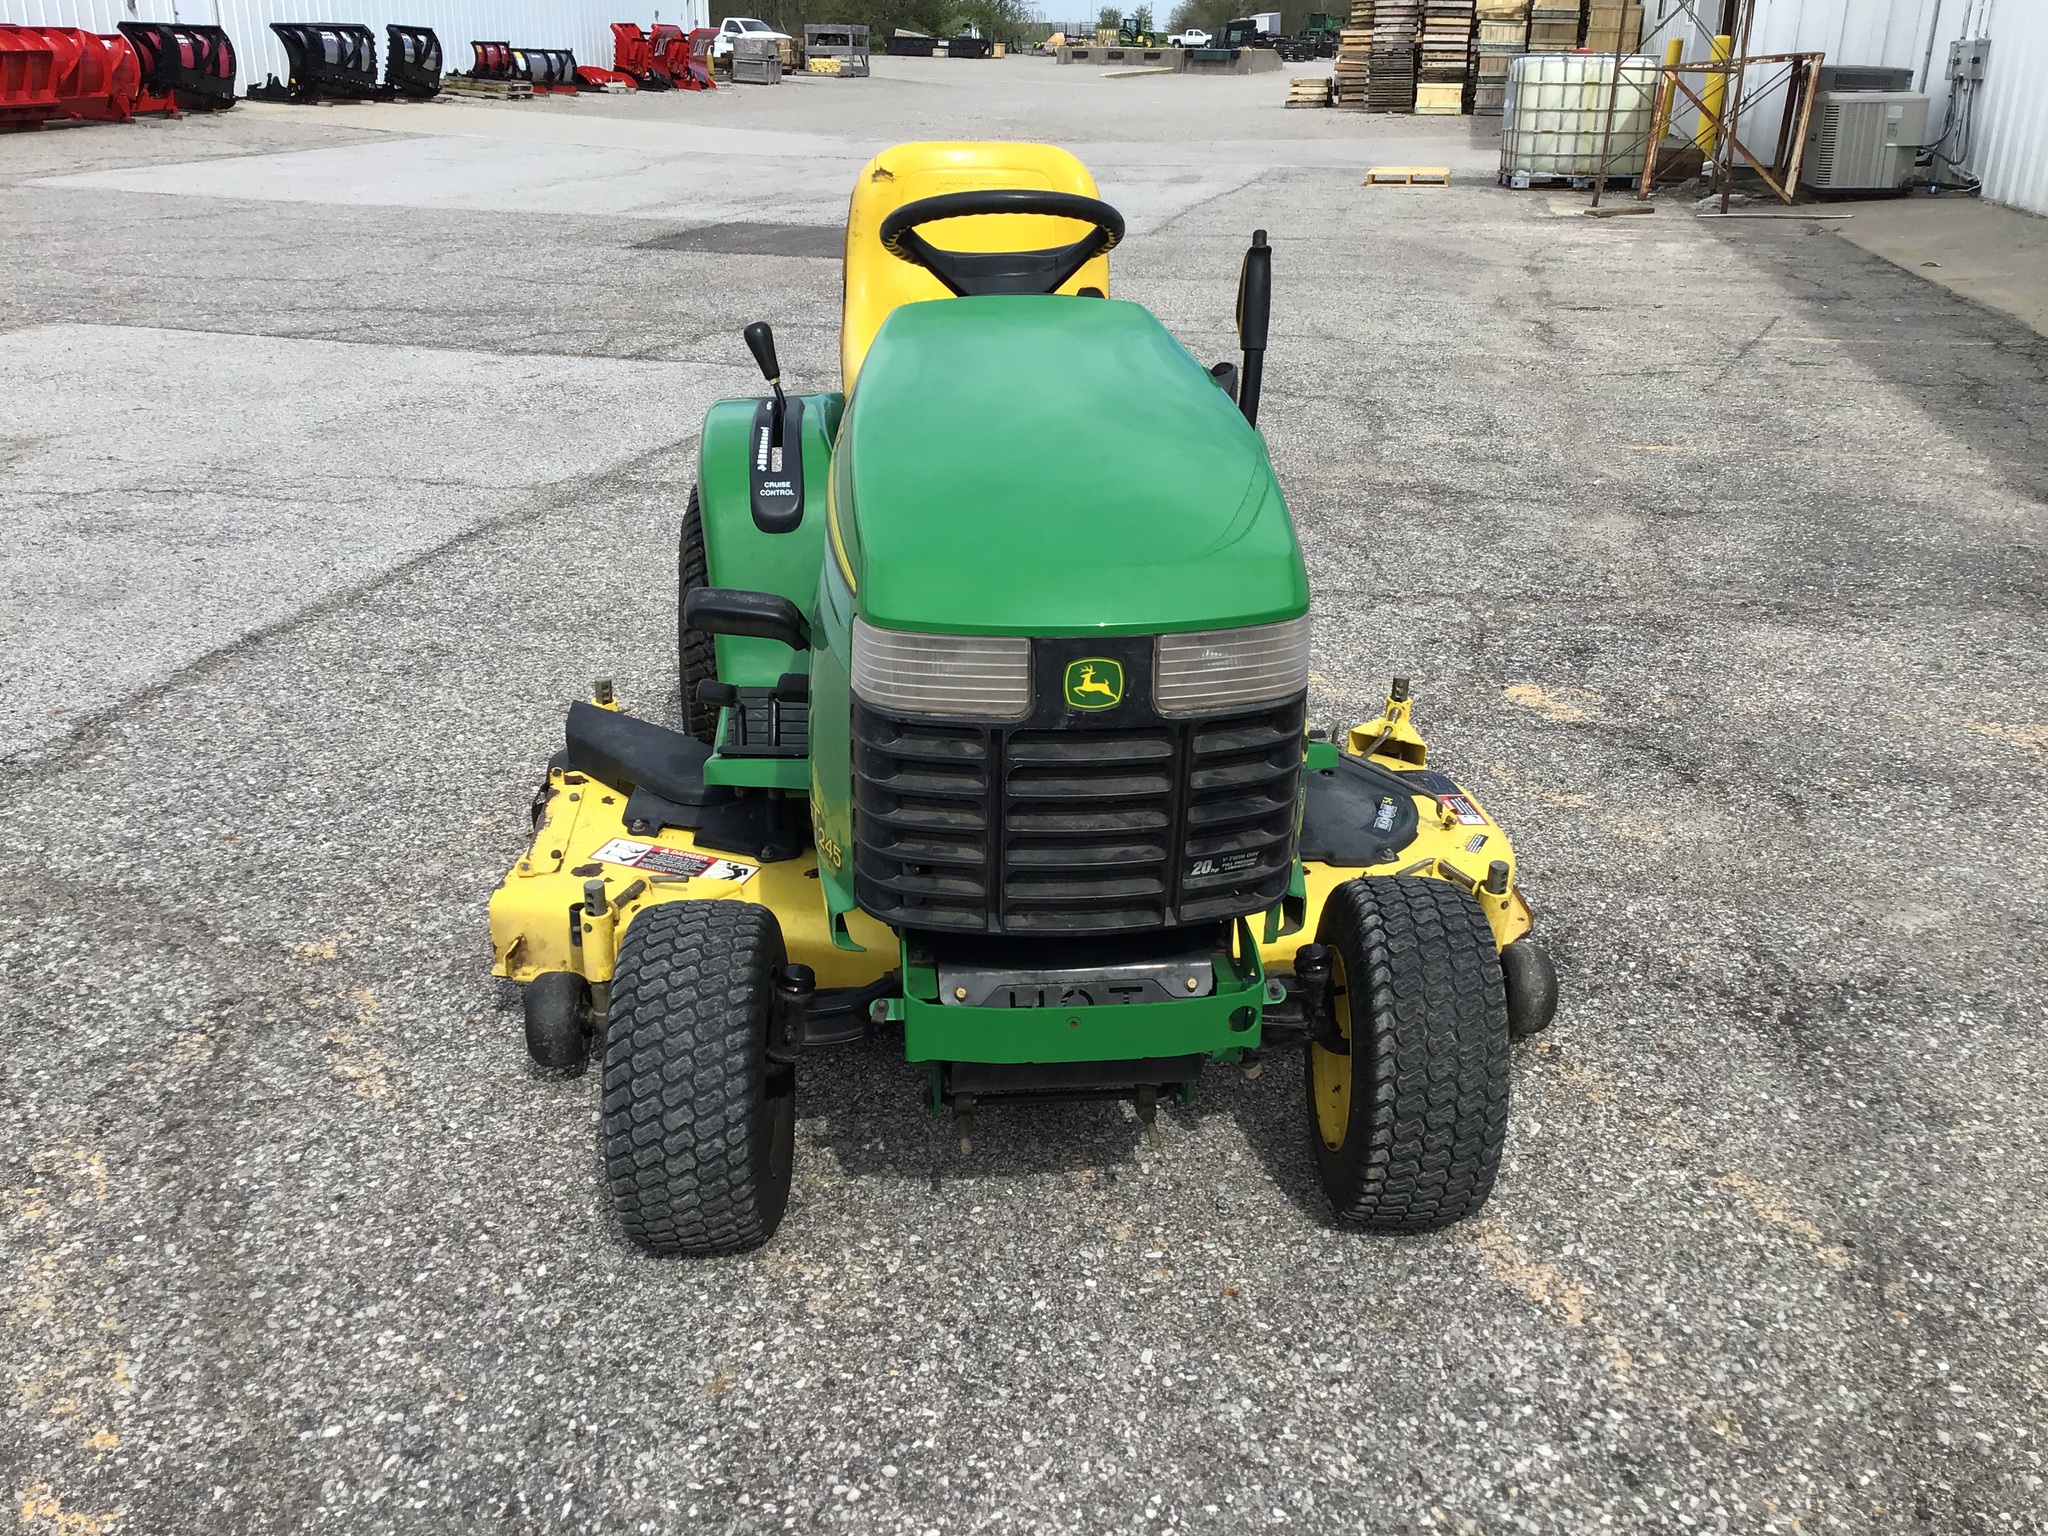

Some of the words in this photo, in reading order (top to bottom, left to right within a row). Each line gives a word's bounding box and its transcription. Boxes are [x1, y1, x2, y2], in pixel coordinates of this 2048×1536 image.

[760, 489, 795, 497] CONTROL
[1374, 803, 1397, 832] EDGE
[670, 850, 709, 861] DANGER
[1190, 860, 1213, 875] 20
